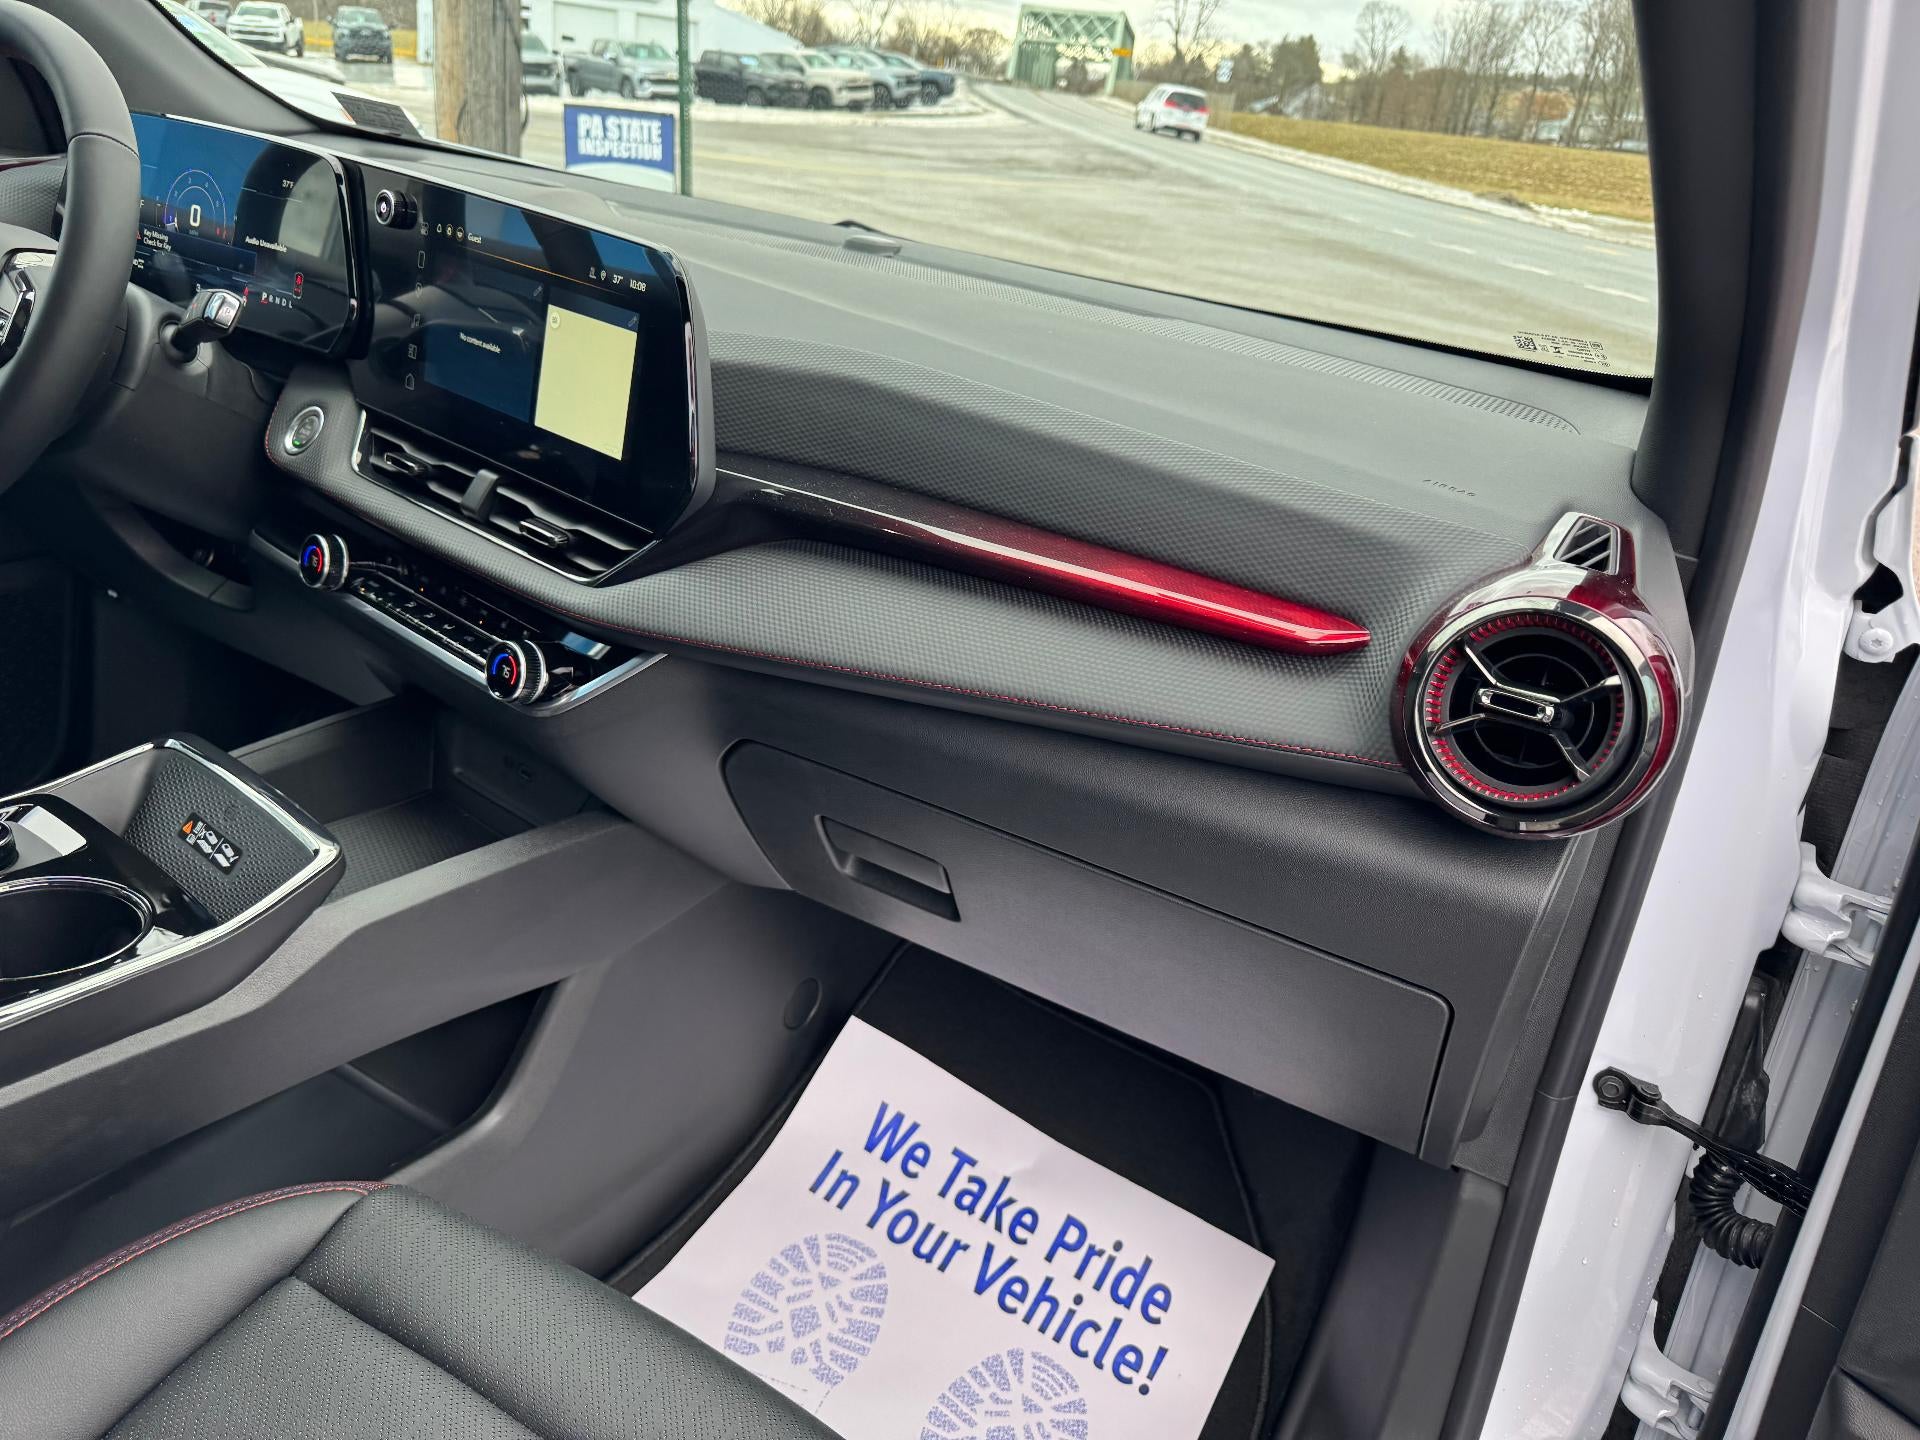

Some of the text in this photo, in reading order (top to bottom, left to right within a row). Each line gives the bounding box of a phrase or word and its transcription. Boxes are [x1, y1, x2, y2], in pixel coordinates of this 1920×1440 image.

[577, 113, 662, 145] PA STATE
[577, 138, 662, 161] INSPECTION
[189, 204, 201, 227] 0
[143, 228, 169, 242] Key Missing
[143, 236, 157, 247] Check
[163, 242, 172, 252] Key
[245, 235, 259, 246] Audio
[467, 232, 482, 244] Guest
[629, 278, 647, 292] 10:08
[863, 1101, 1172, 1325] We Take Pride
[809, 1150, 1169, 1396] In Your Vehicle!
